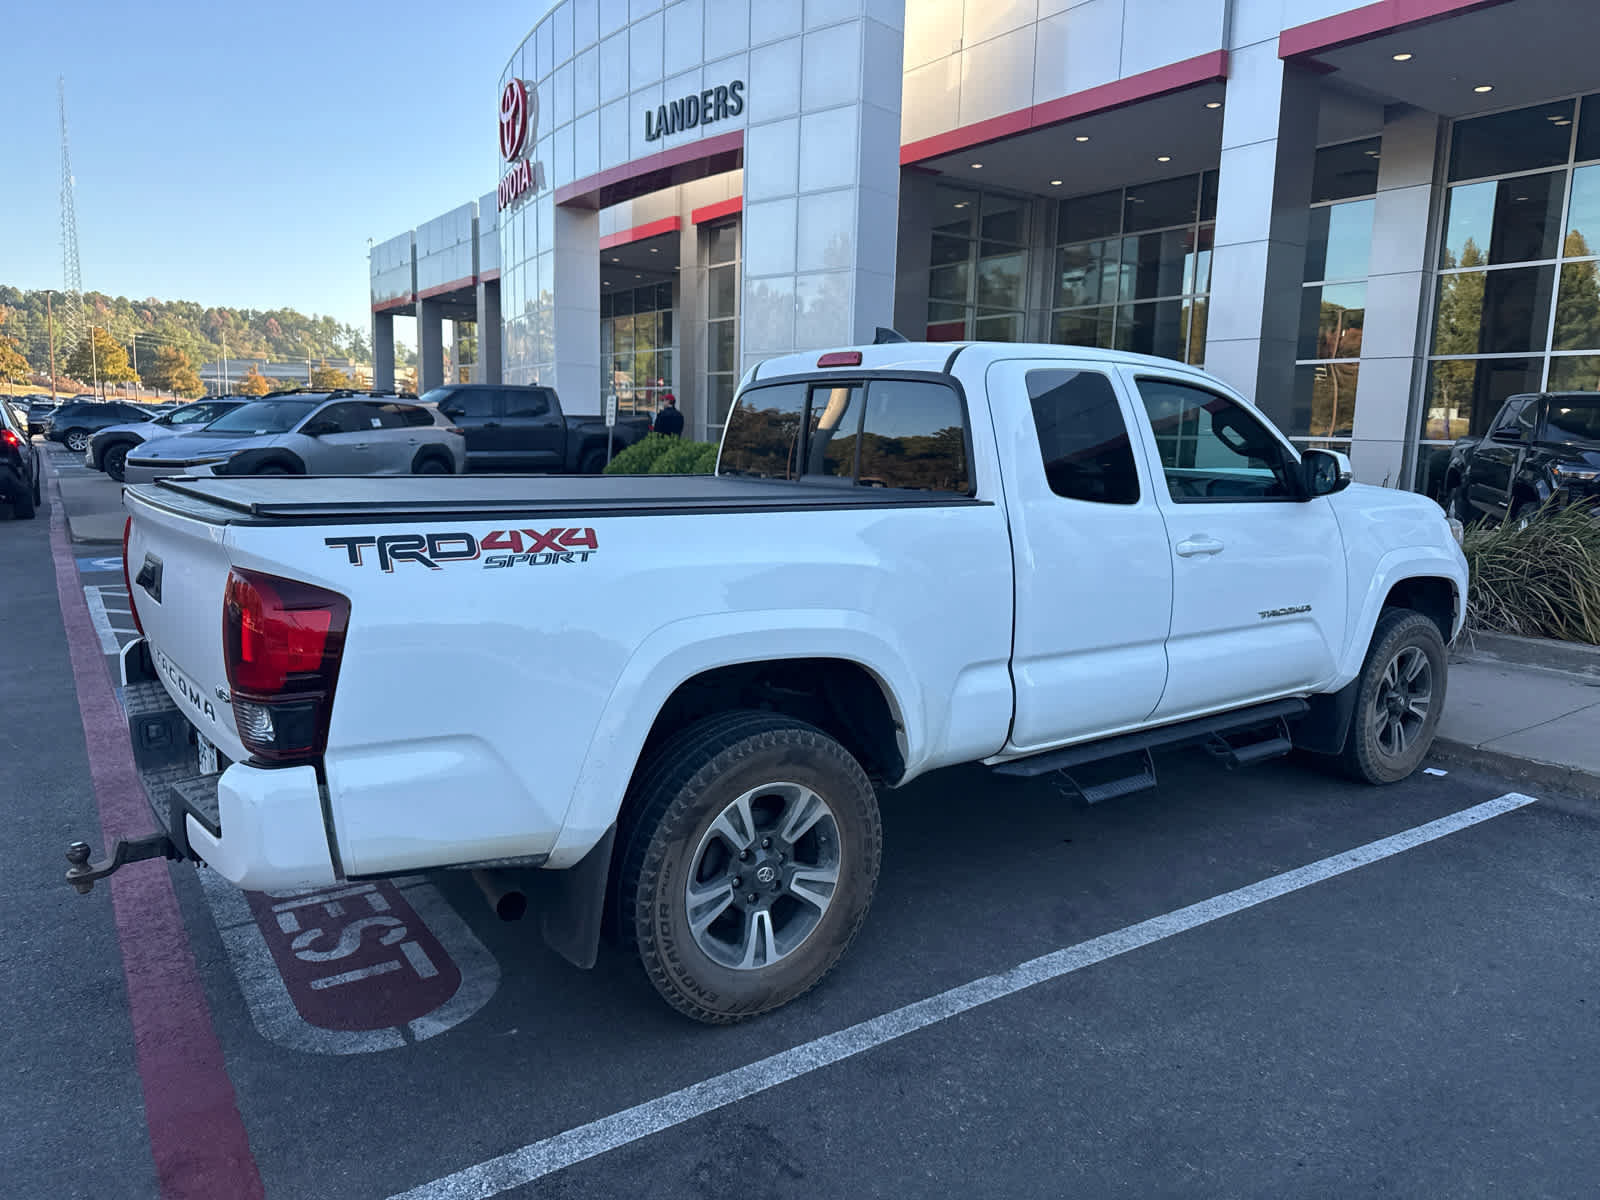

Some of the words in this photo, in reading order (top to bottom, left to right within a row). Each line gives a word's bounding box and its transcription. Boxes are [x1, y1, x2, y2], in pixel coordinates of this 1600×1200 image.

[645, 79, 745, 143] LANDERS
[497, 158, 533, 214] OYOTA
[324, 531, 480, 573] TRD
[483, 549, 597, 570] SPORT
[155, 647, 217, 723] TACOMA
[266, 880, 439, 991] EST
